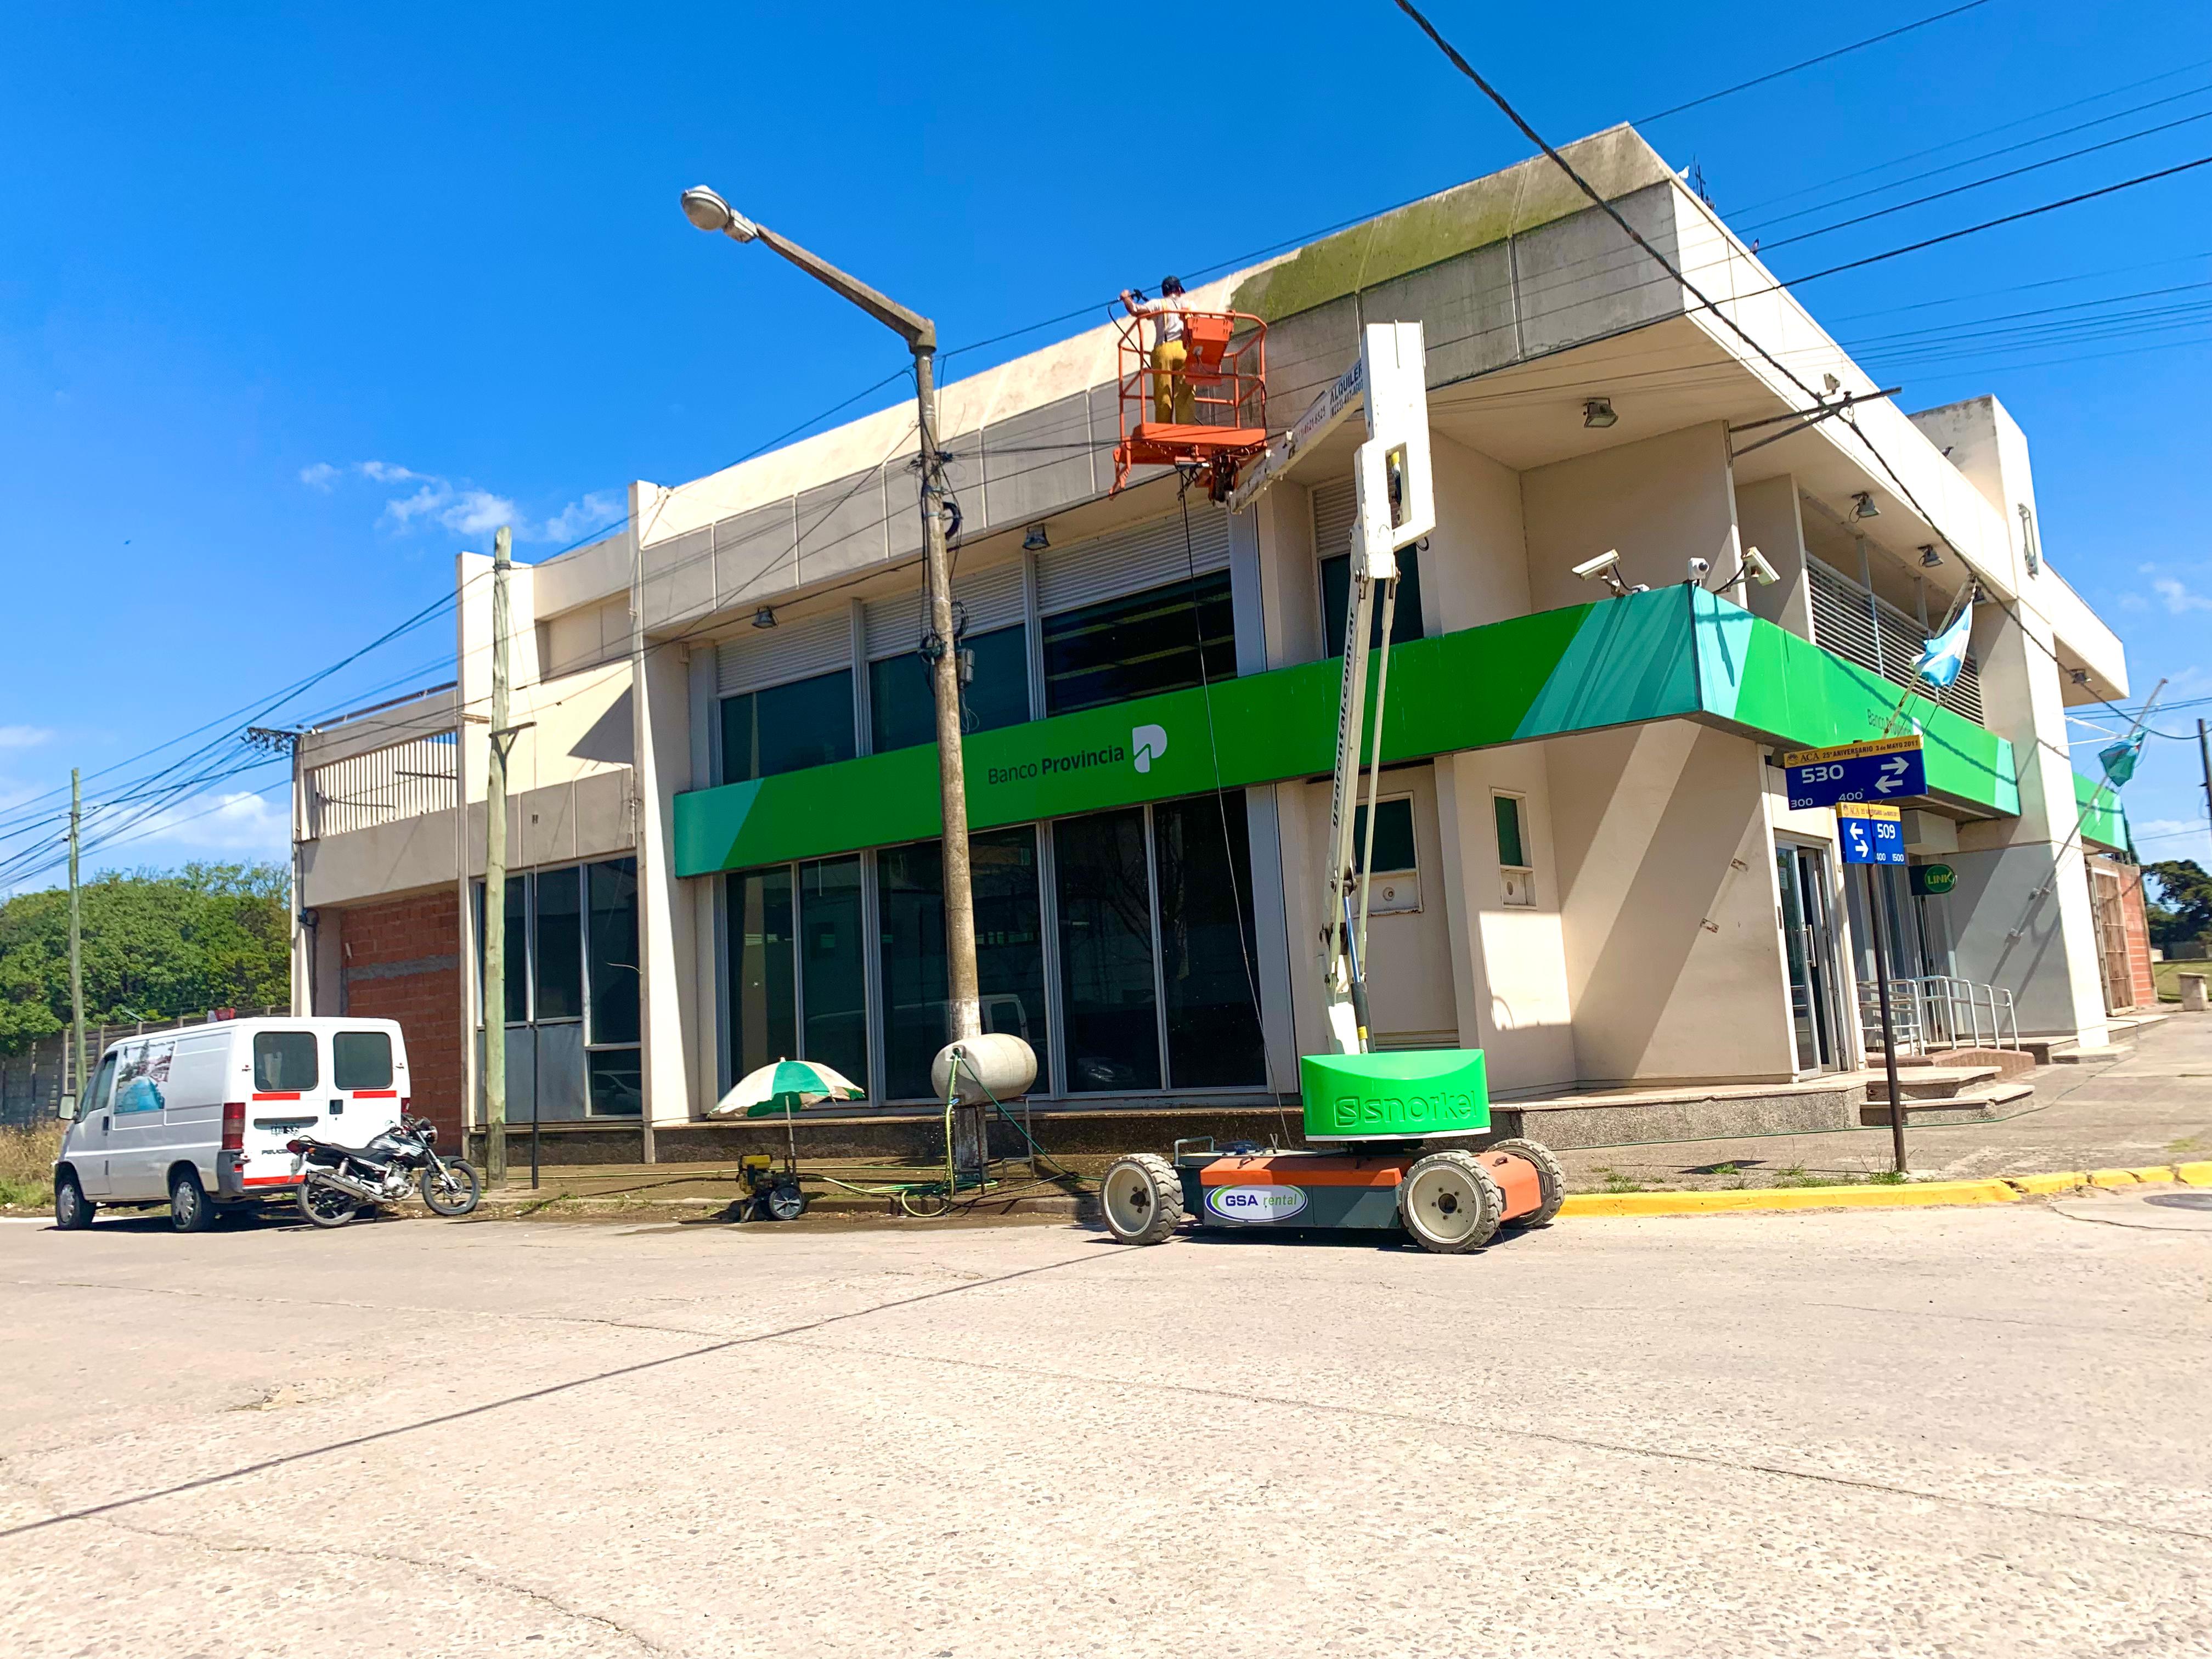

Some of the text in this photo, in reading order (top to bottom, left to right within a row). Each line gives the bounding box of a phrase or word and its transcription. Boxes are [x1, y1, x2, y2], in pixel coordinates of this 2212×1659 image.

[1801, 752, 1820, 762] ACA
[1833, 746, 1874, 757] ANIVERSARIO
[988, 763, 1037, 785] Banco
[1042, 745, 1124, 775] Provincia
[1801, 764, 1844, 784] 530
[1791, 791, 1863, 808] 300 400
[1877, 823, 1896, 839] 509
[1364, 1090, 1477, 1124] snorkel
[1226, 1194, 1297, 1206] GSA rental
